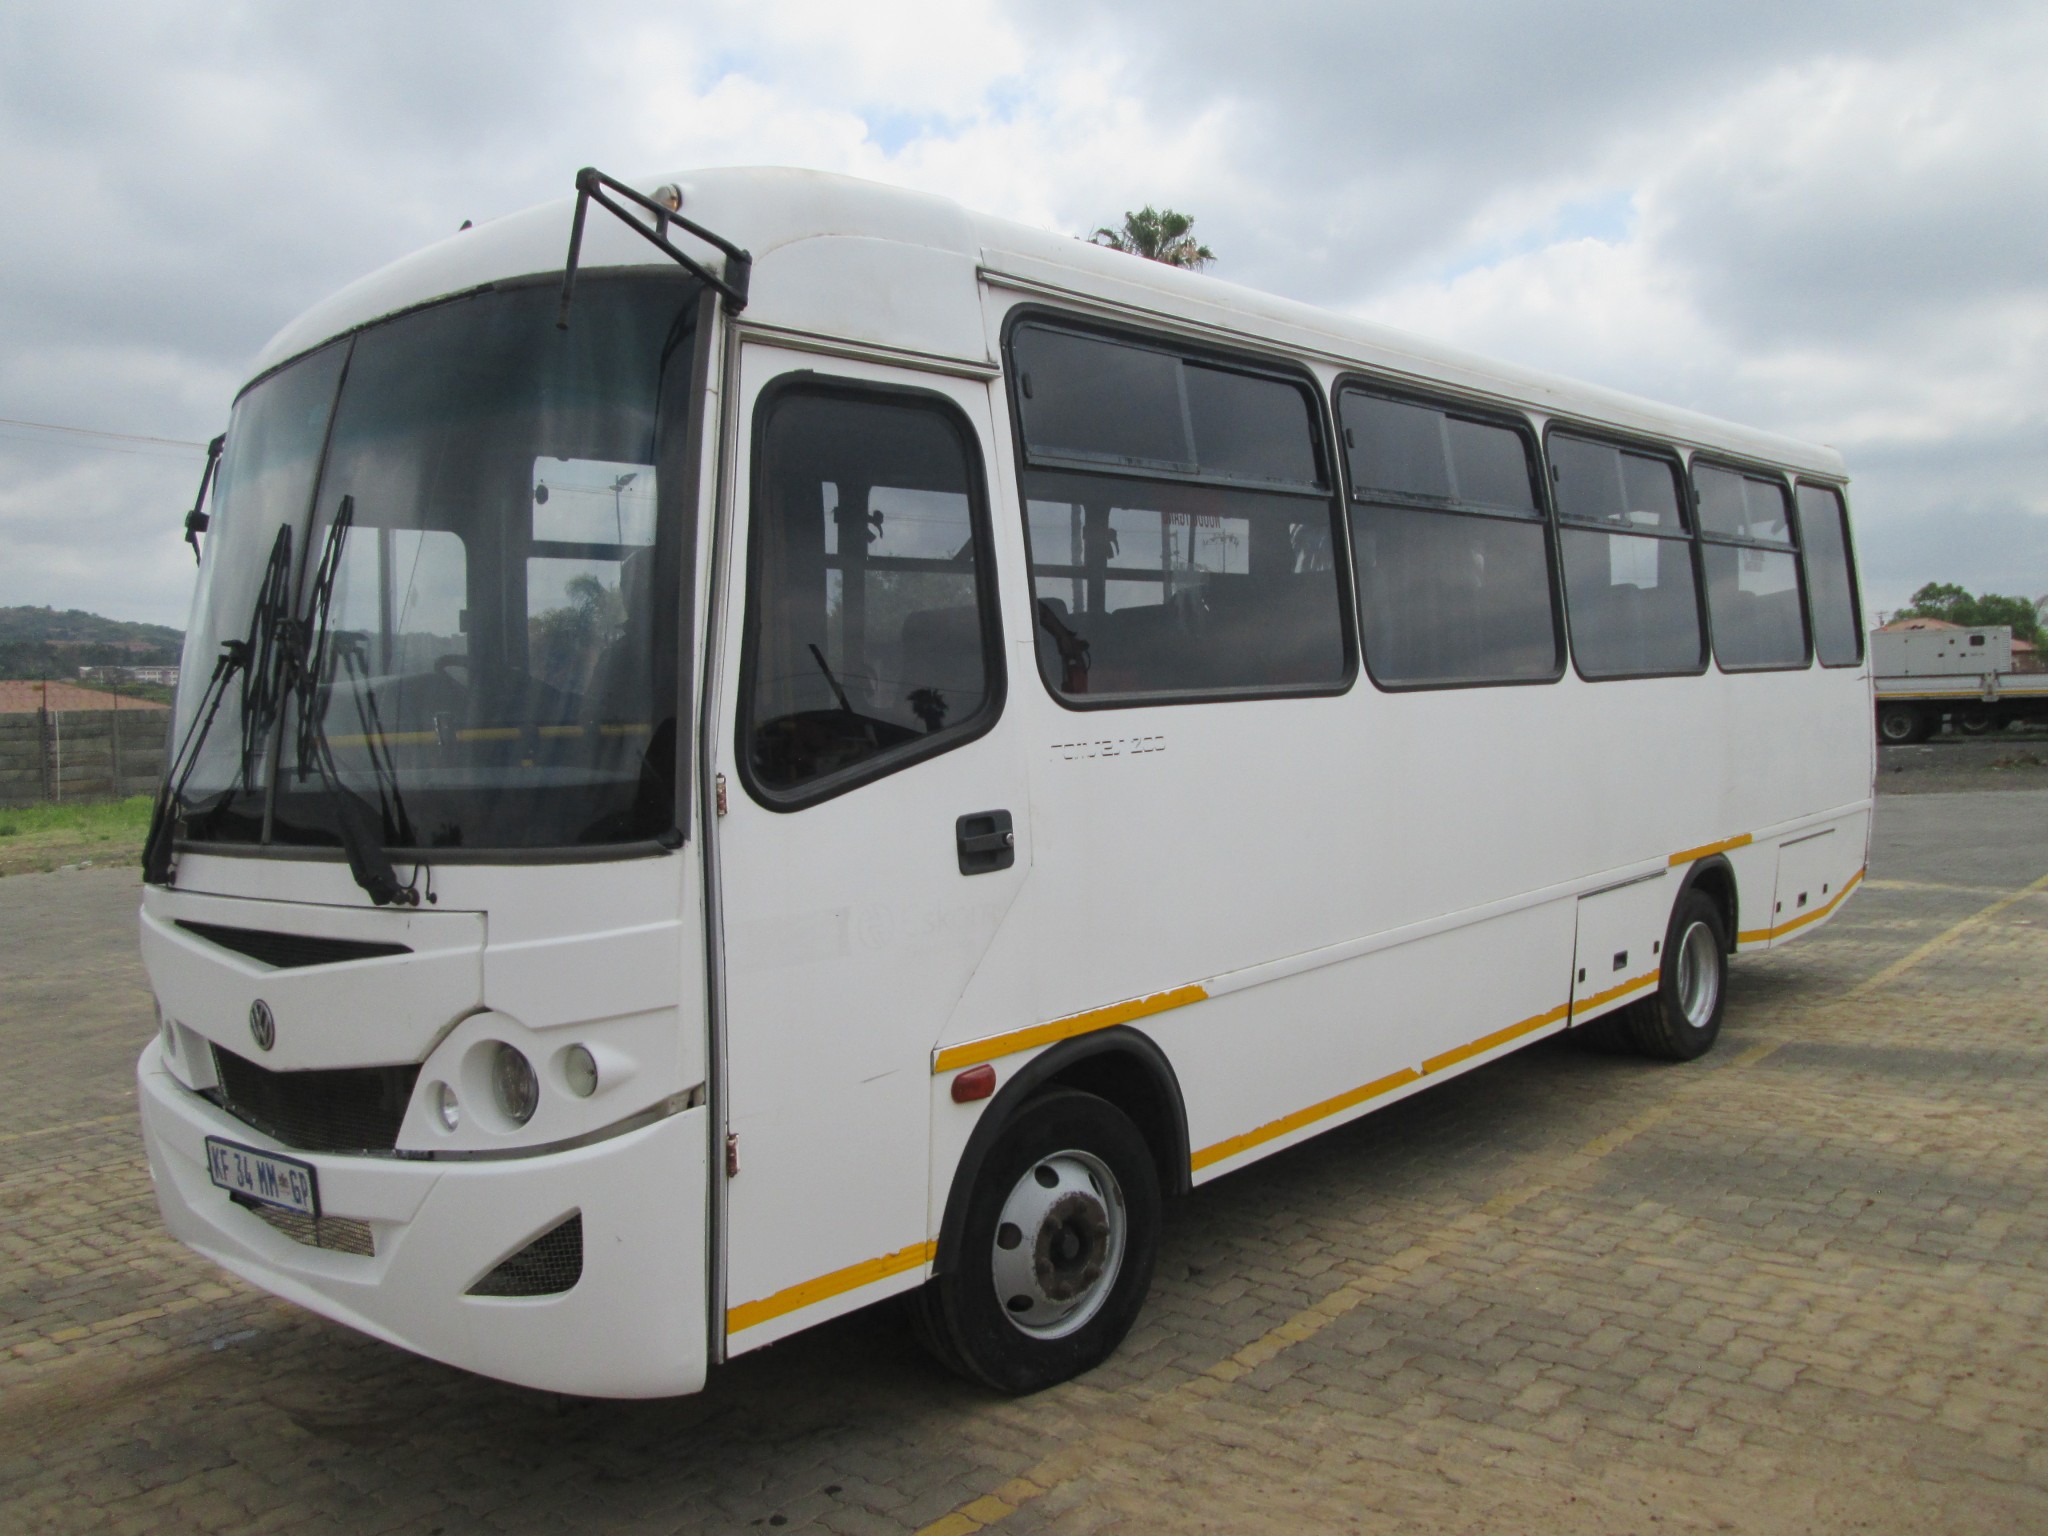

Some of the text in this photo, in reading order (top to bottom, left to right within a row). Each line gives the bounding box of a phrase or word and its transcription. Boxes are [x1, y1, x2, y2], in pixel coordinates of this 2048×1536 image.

[1130, 735, 1165, 754] 200
[250, 998, 275, 1051] VW
[211, 1146, 228, 1181] KF
[234, 1153, 254, 1191] 34
[289, 1169, 309, 1207] GP
